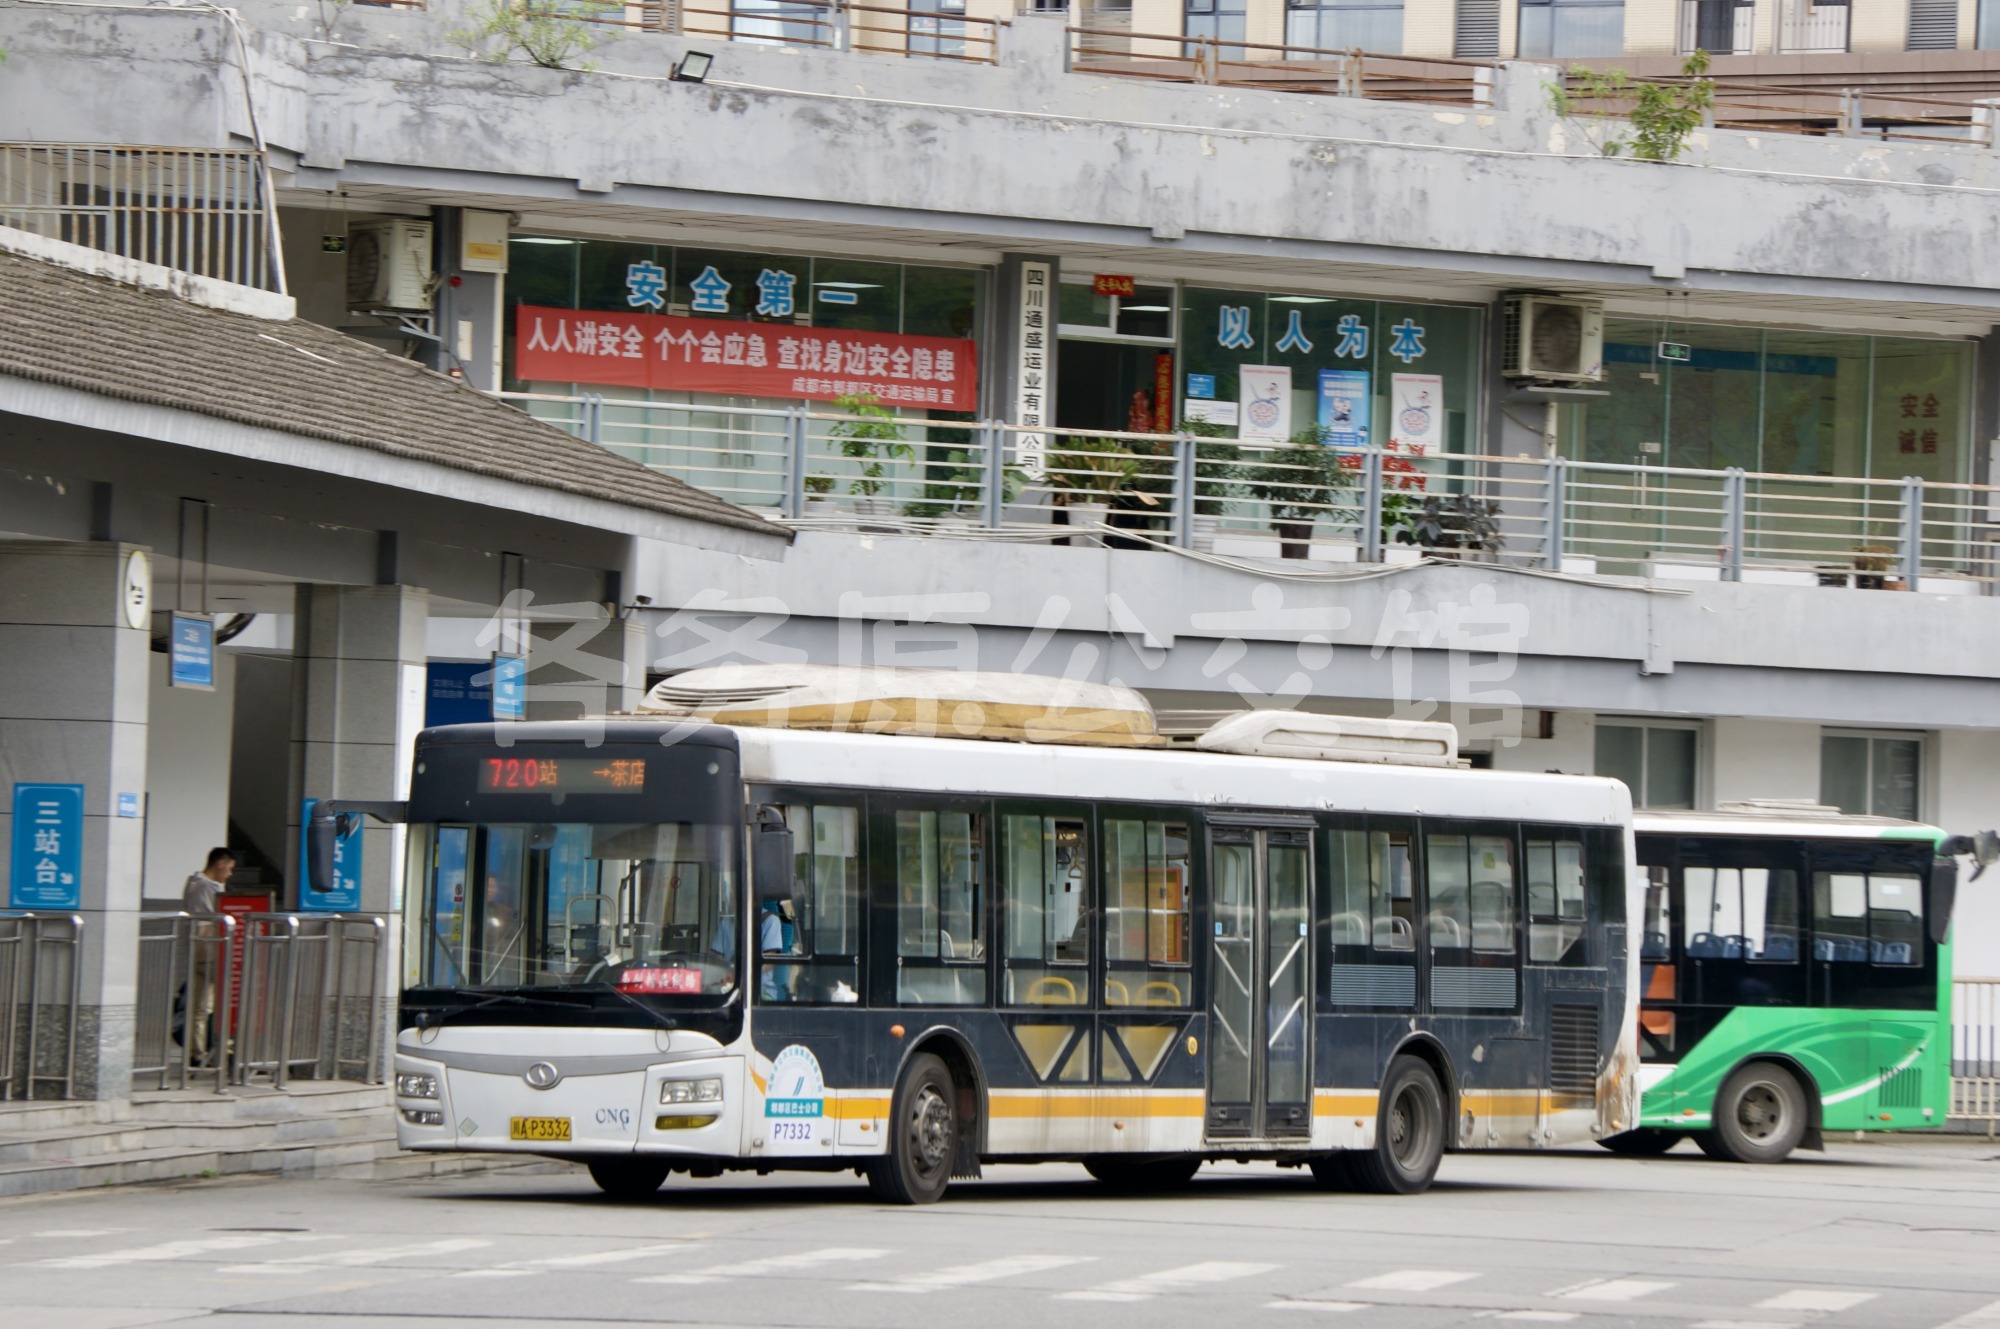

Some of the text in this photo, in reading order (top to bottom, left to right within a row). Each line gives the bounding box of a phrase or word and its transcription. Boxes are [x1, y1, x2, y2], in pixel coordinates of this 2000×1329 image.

[626, 258, 860, 318] 安全第一
[526, 315, 956, 382] 人人讲安全 个个会应急 查找身边安全隐患
[1217, 304, 1427, 365] 以人为本
[1020, 268, 1045, 475] 四川通盛运业有限公司
[791, 376, 956, 405] 成都市郫都区交通运输局 宣
[1900, 392, 1941, 419] 安全
[1898, 428, 1939, 454] 诚信
[488, 758, 646, 788] 720 站 茶店
[34, 800, 62, 885] 三站台
[595, 1107, 631, 1127] CNG
[773, 1122, 812, 1141] P7332
